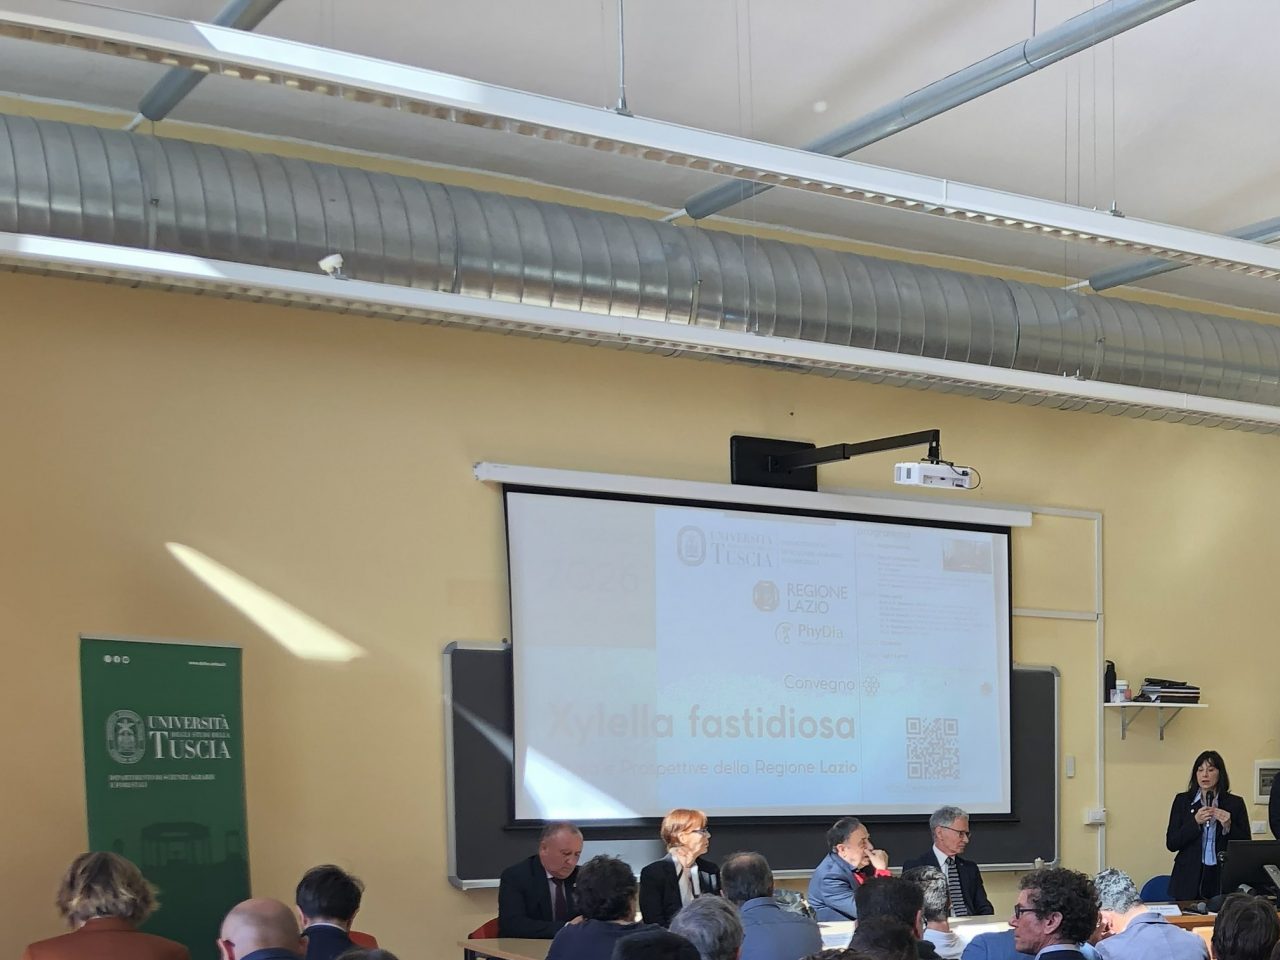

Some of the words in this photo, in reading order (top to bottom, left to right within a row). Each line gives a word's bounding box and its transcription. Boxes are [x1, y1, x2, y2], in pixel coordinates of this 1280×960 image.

[786, 583, 848, 600] REGIONE
[786, 600, 830, 614] LAZIO
[798, 624, 843, 640] PhyDia
[784, 674, 855, 694] Convegno
[148, 714, 230, 730] UNIVERSITÀ
[549, 702, 674, 746] Xylella
[687, 703, 855, 739] fastidiosa
[149, 731, 231, 759] TUSCIA
[713, 760, 749, 775] della
[755, 760, 816, 778] Regione
[820, 760, 858, 774] Lazio
